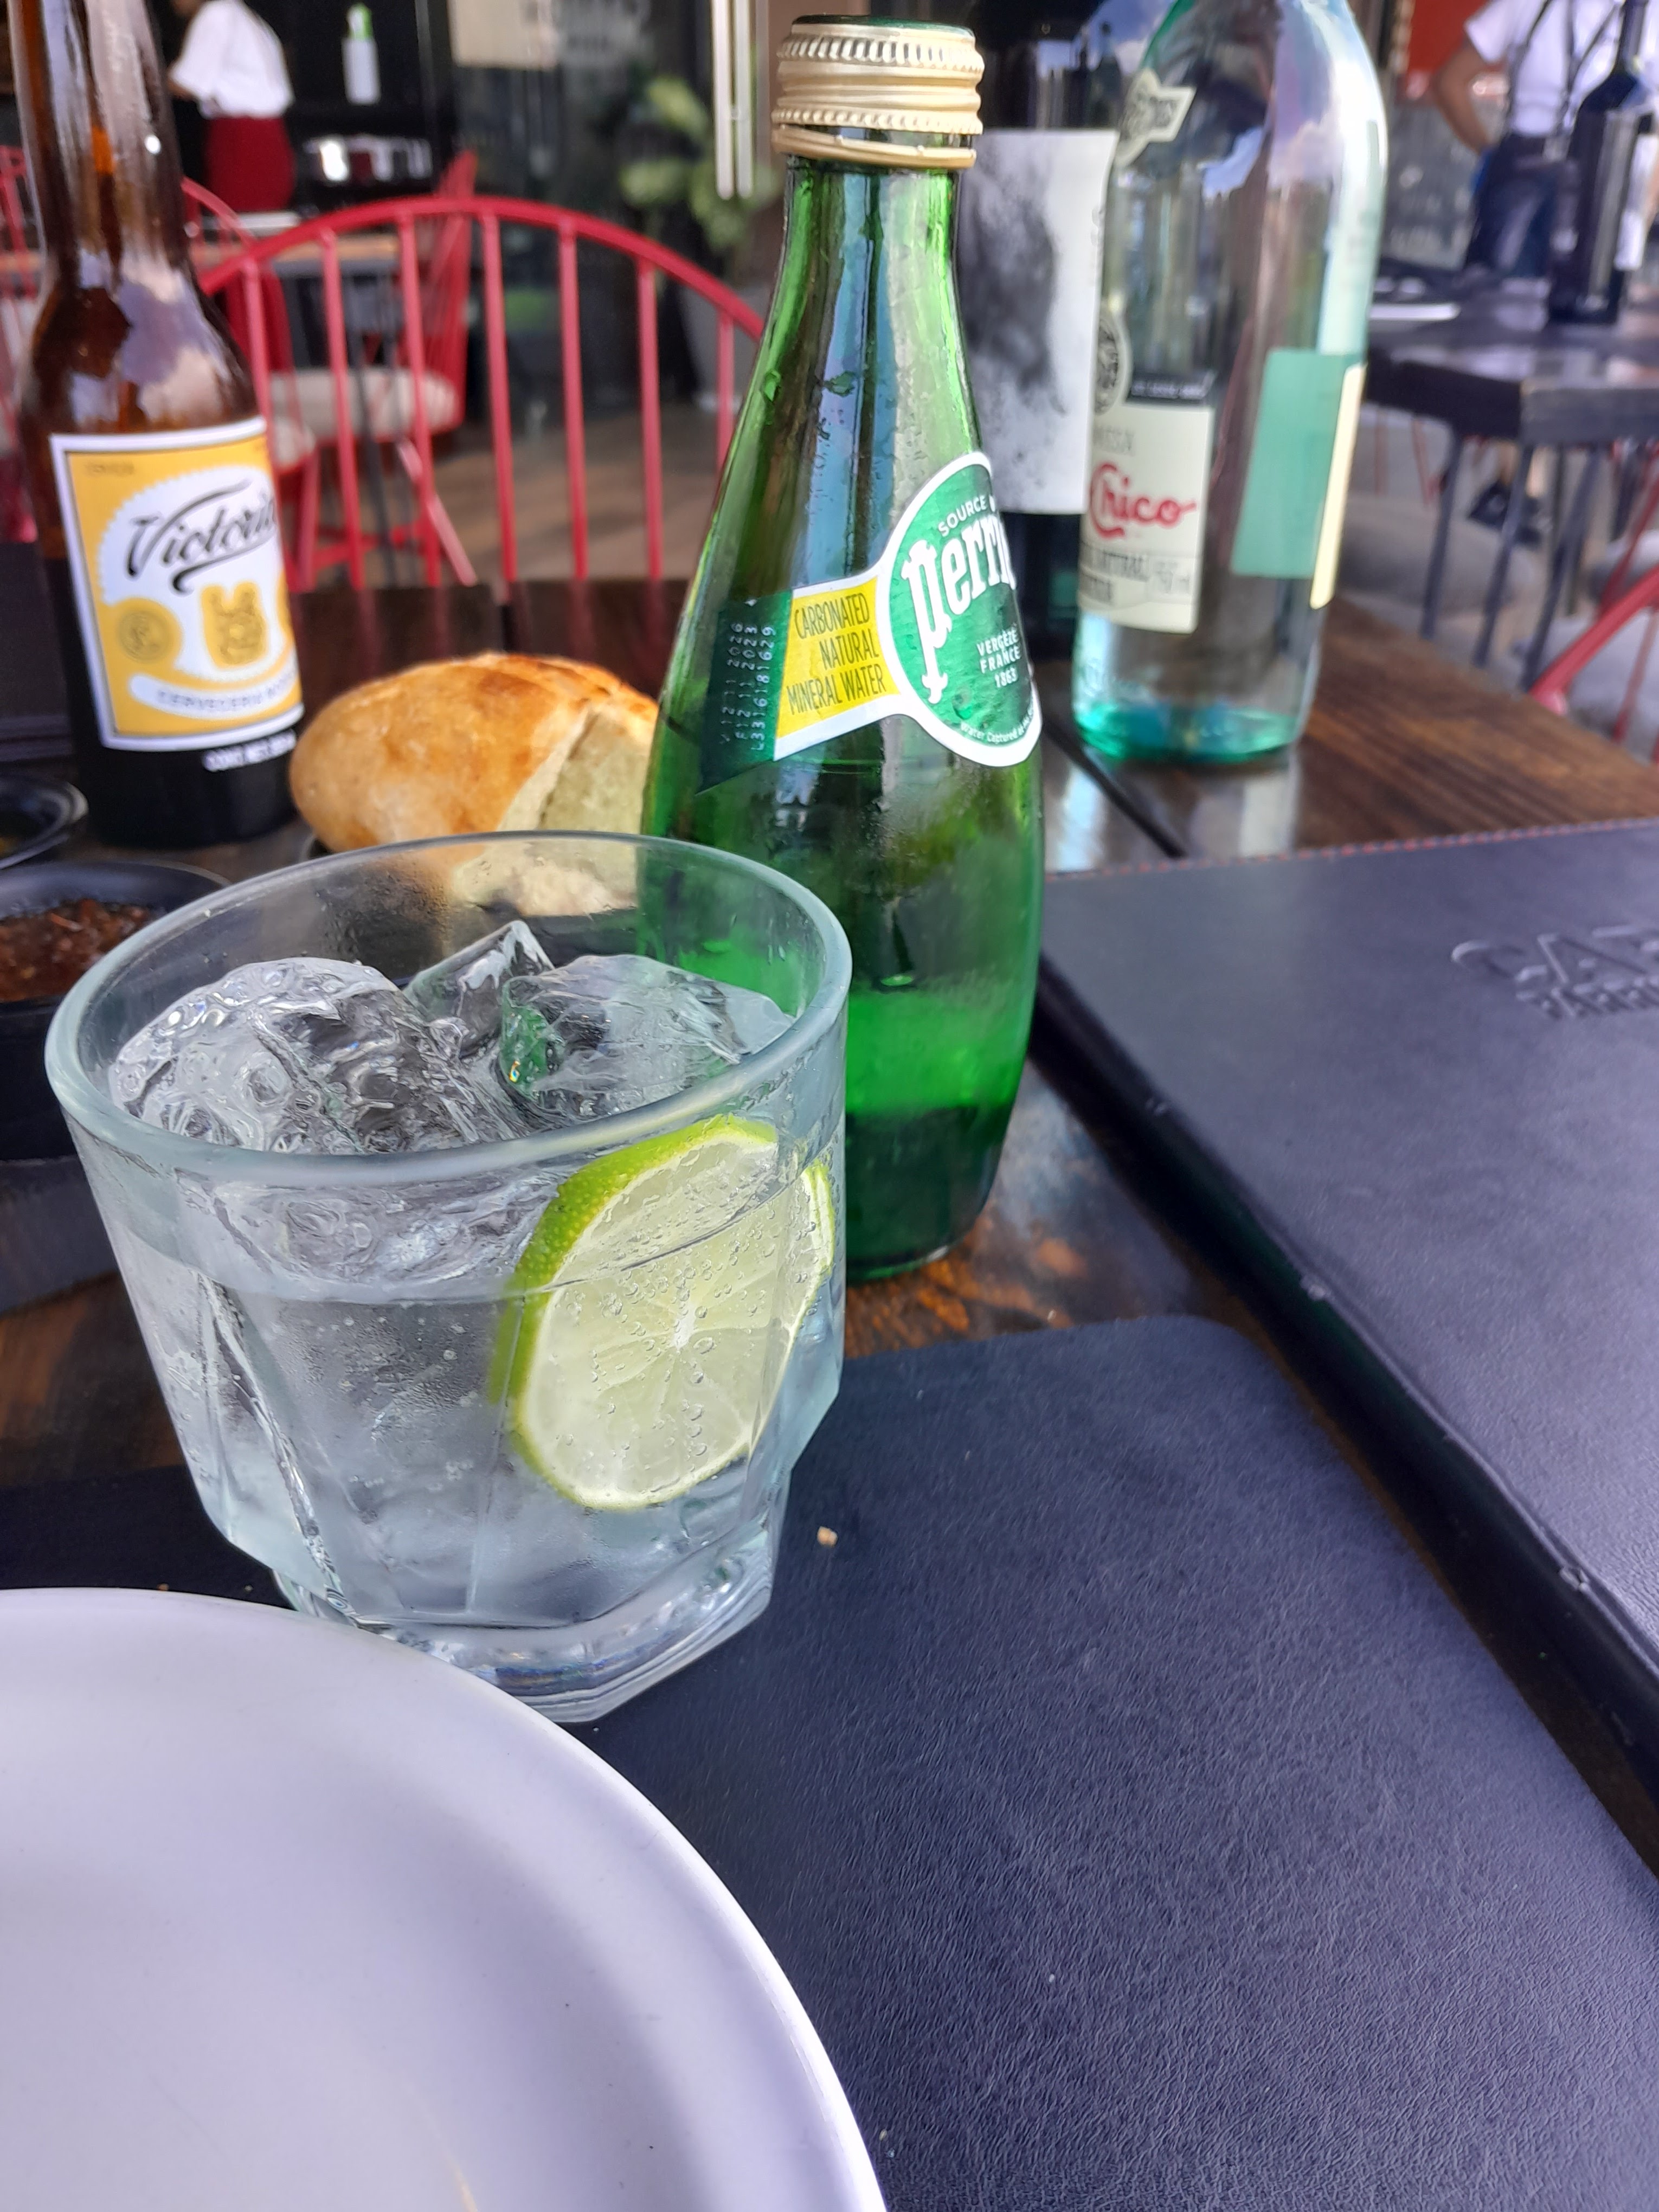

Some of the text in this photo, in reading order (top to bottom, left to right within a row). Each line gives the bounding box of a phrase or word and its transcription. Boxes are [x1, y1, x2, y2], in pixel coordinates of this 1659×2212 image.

[938, 494, 987, 537] SOURCE
[794, 593, 870, 639] CARBONATED
[819, 628, 879, 671] NATURAL
[980, 645, 1021, 673] FRANCE
[786, 663, 886, 716] MINERAL WATER
[994, 665, 1017, 687] 1863
